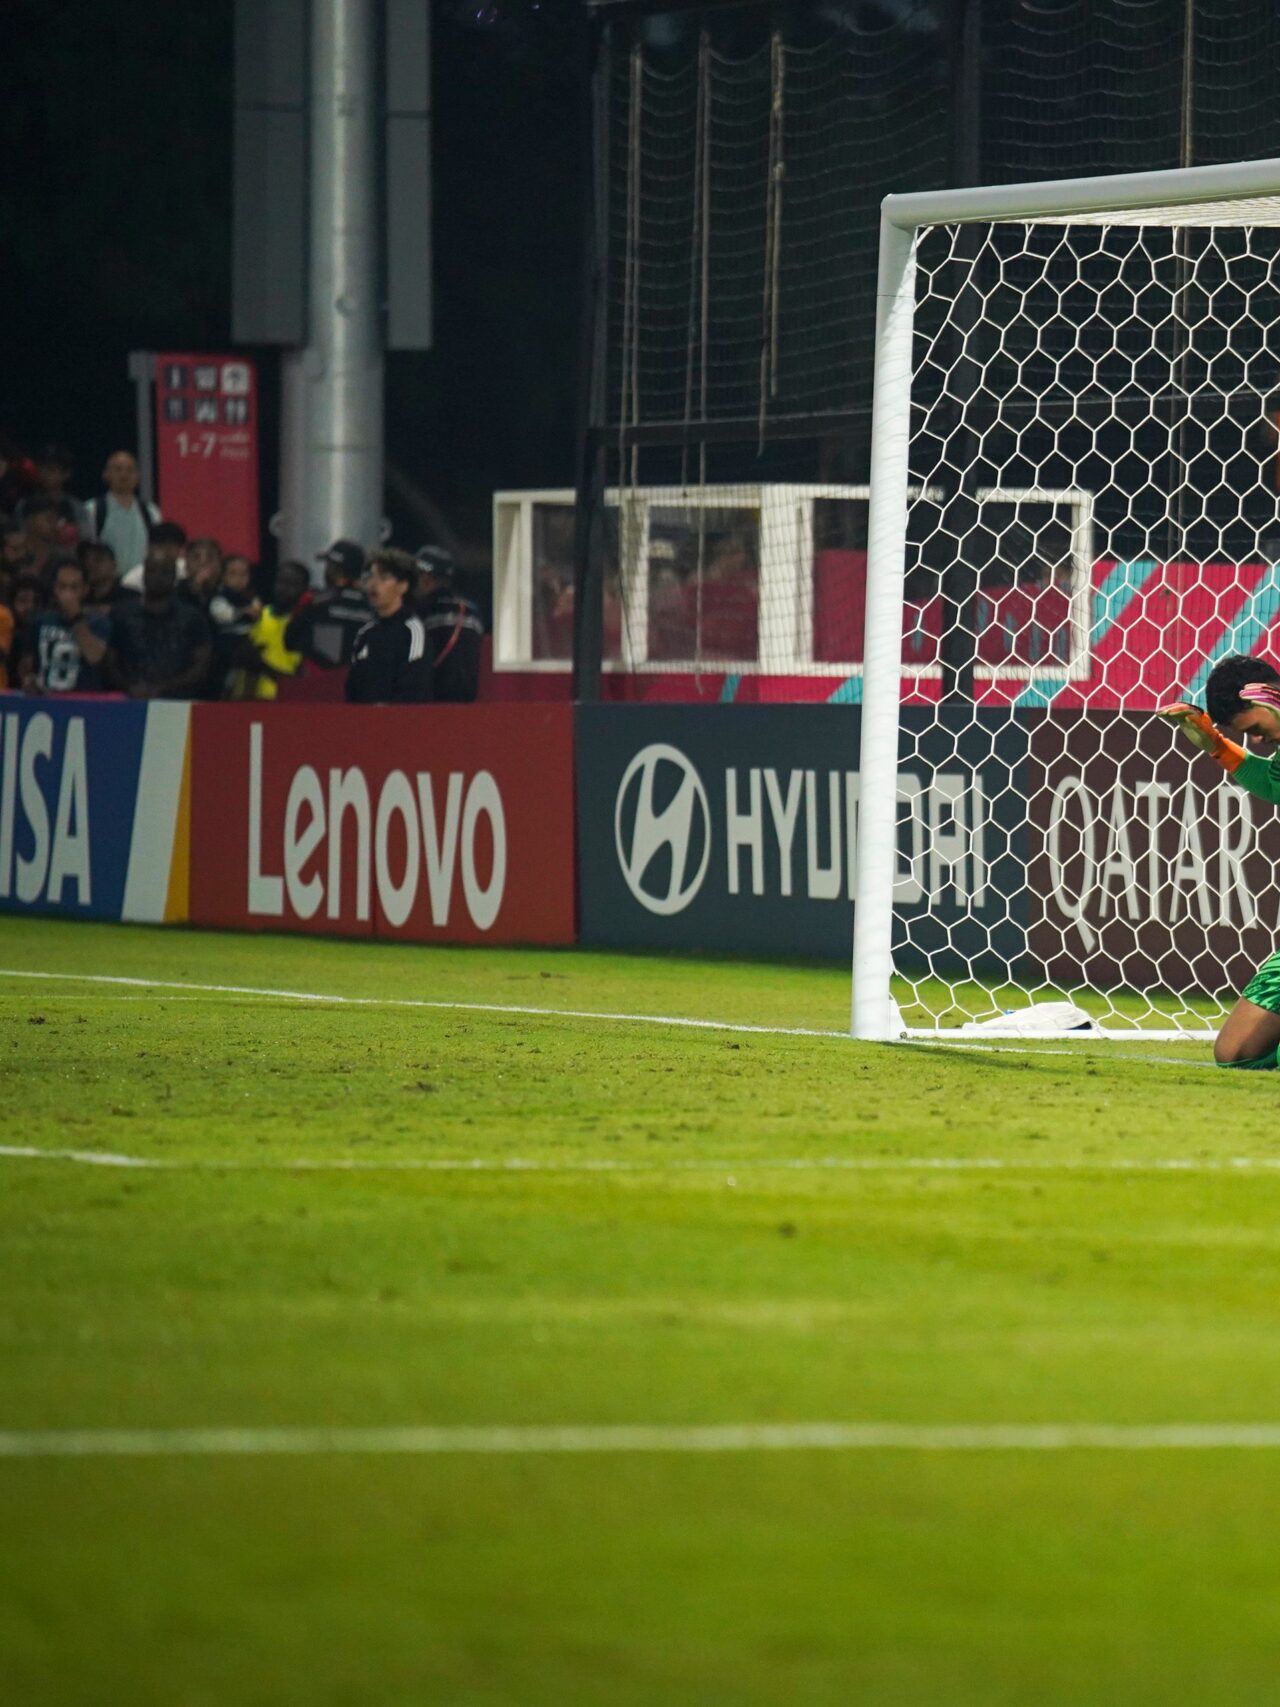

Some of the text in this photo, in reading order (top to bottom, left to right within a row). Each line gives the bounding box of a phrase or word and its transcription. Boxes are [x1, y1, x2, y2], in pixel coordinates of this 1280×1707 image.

[0, 711, 92, 905] ISA
[248, 722, 506, 931] Lenovo
[1048, 775, 1258, 954] QATAR
